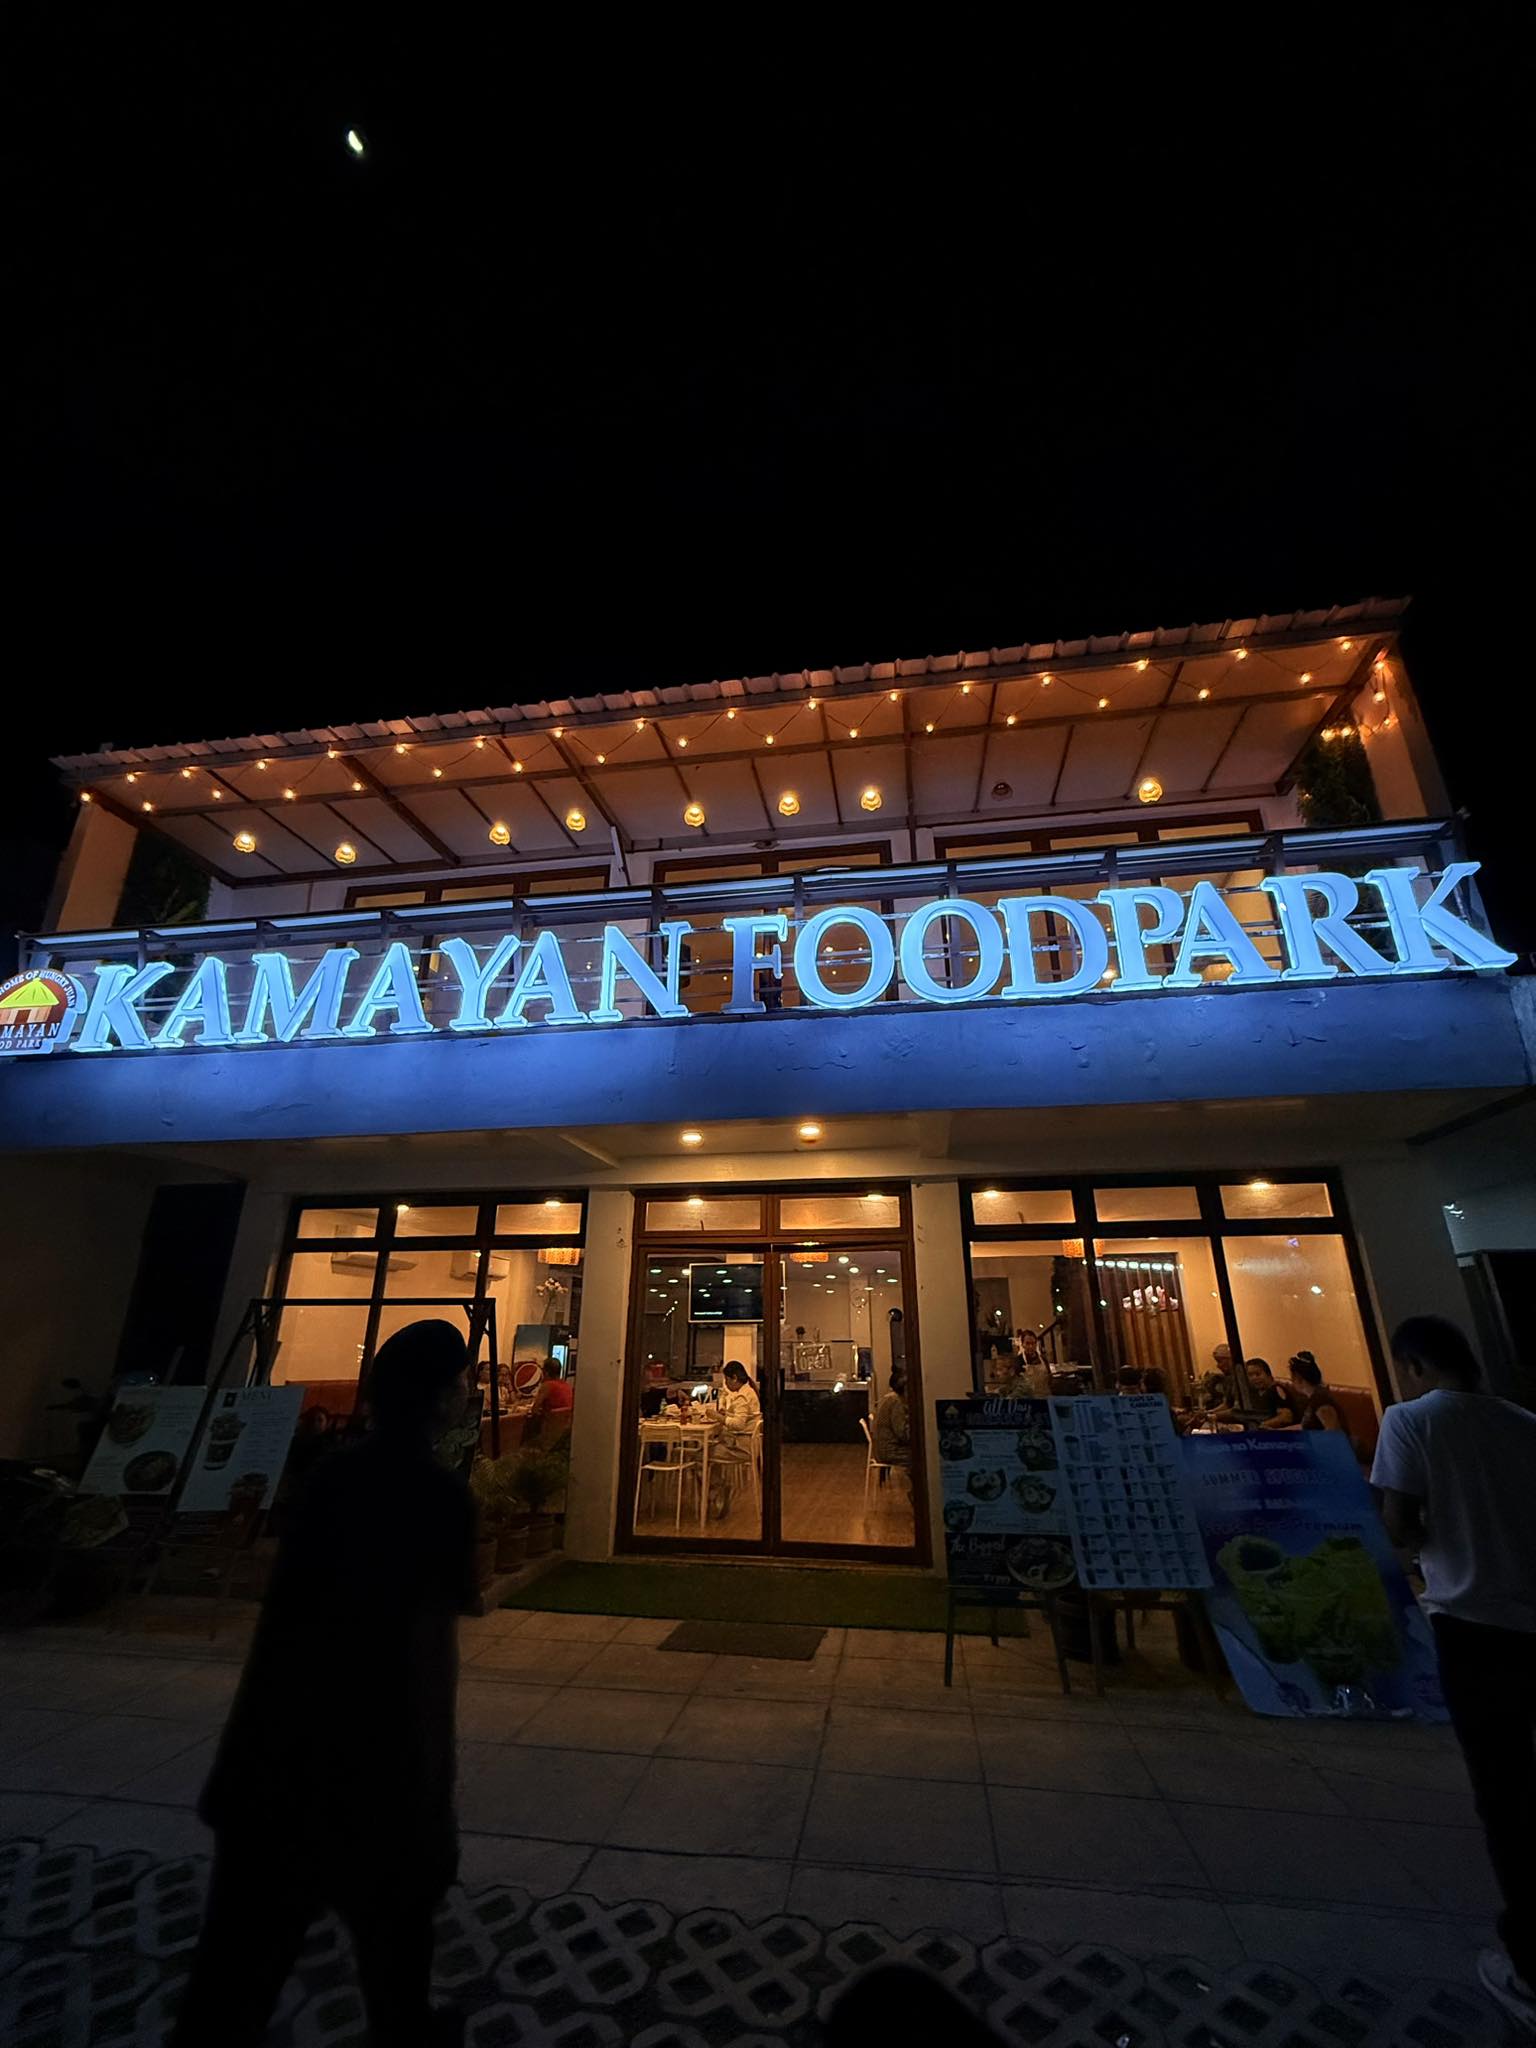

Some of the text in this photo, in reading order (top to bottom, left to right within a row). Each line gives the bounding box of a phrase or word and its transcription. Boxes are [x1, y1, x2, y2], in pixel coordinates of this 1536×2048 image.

[70, 861, 1519, 1053] KAMAYAN FOODPARK
[25, 970, 39, 980] OF
[39, 970, 69, 987] HUNGRY
[64, 986, 76, 1008] JUAN
[16, 1038, 41, 1048] PARK
